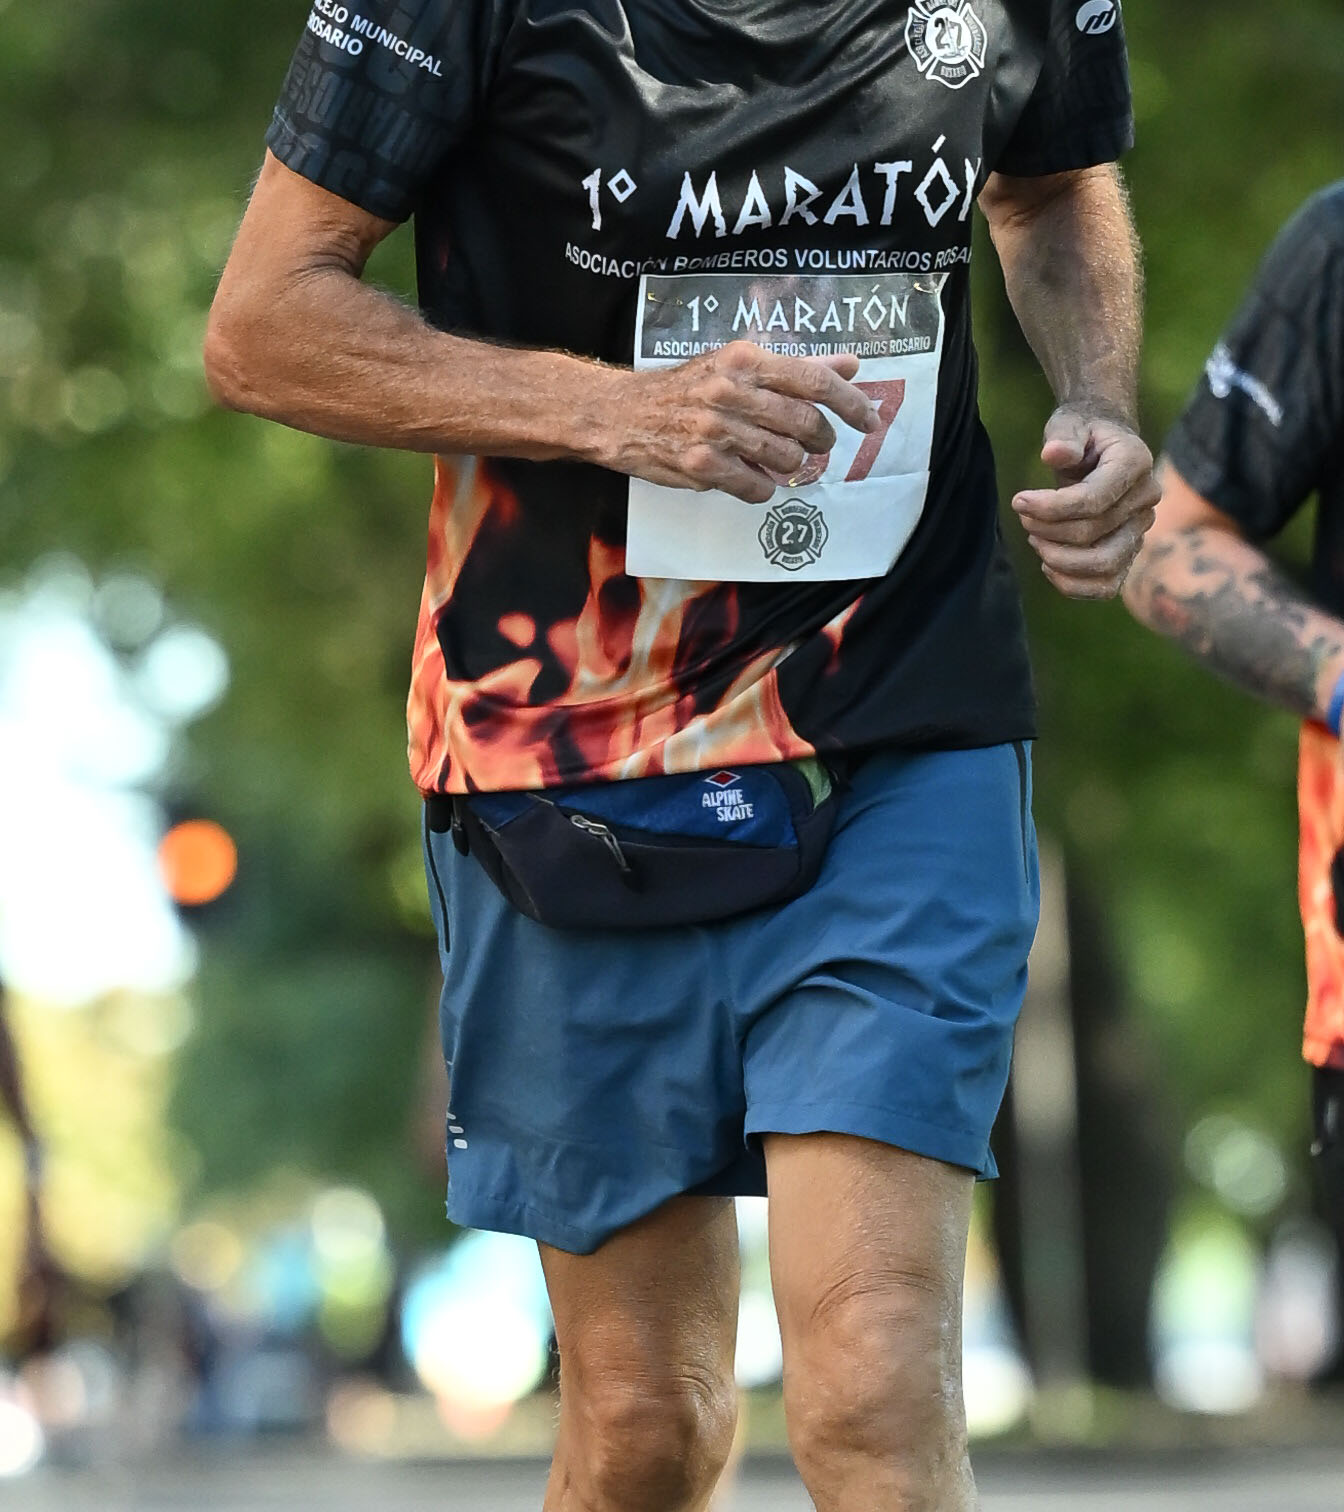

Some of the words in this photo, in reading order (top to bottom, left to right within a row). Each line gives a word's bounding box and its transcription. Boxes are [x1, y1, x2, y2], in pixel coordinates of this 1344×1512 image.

[351, 14, 443, 77] MUNICIPAL
[674, 248, 787, 272] BOMBEROS
[794, 248, 931, 271] VOLUNTARIOS
[732, 284, 910, 333] MARATÓN
[810, 340, 888, 357] VOLUNTARIOS
[889, 336, 931, 354] ROSARIO
[782, 521, 808, 545] 27
[702, 789, 744, 808] ALPINE
[717, 803, 754, 822] SKATE
